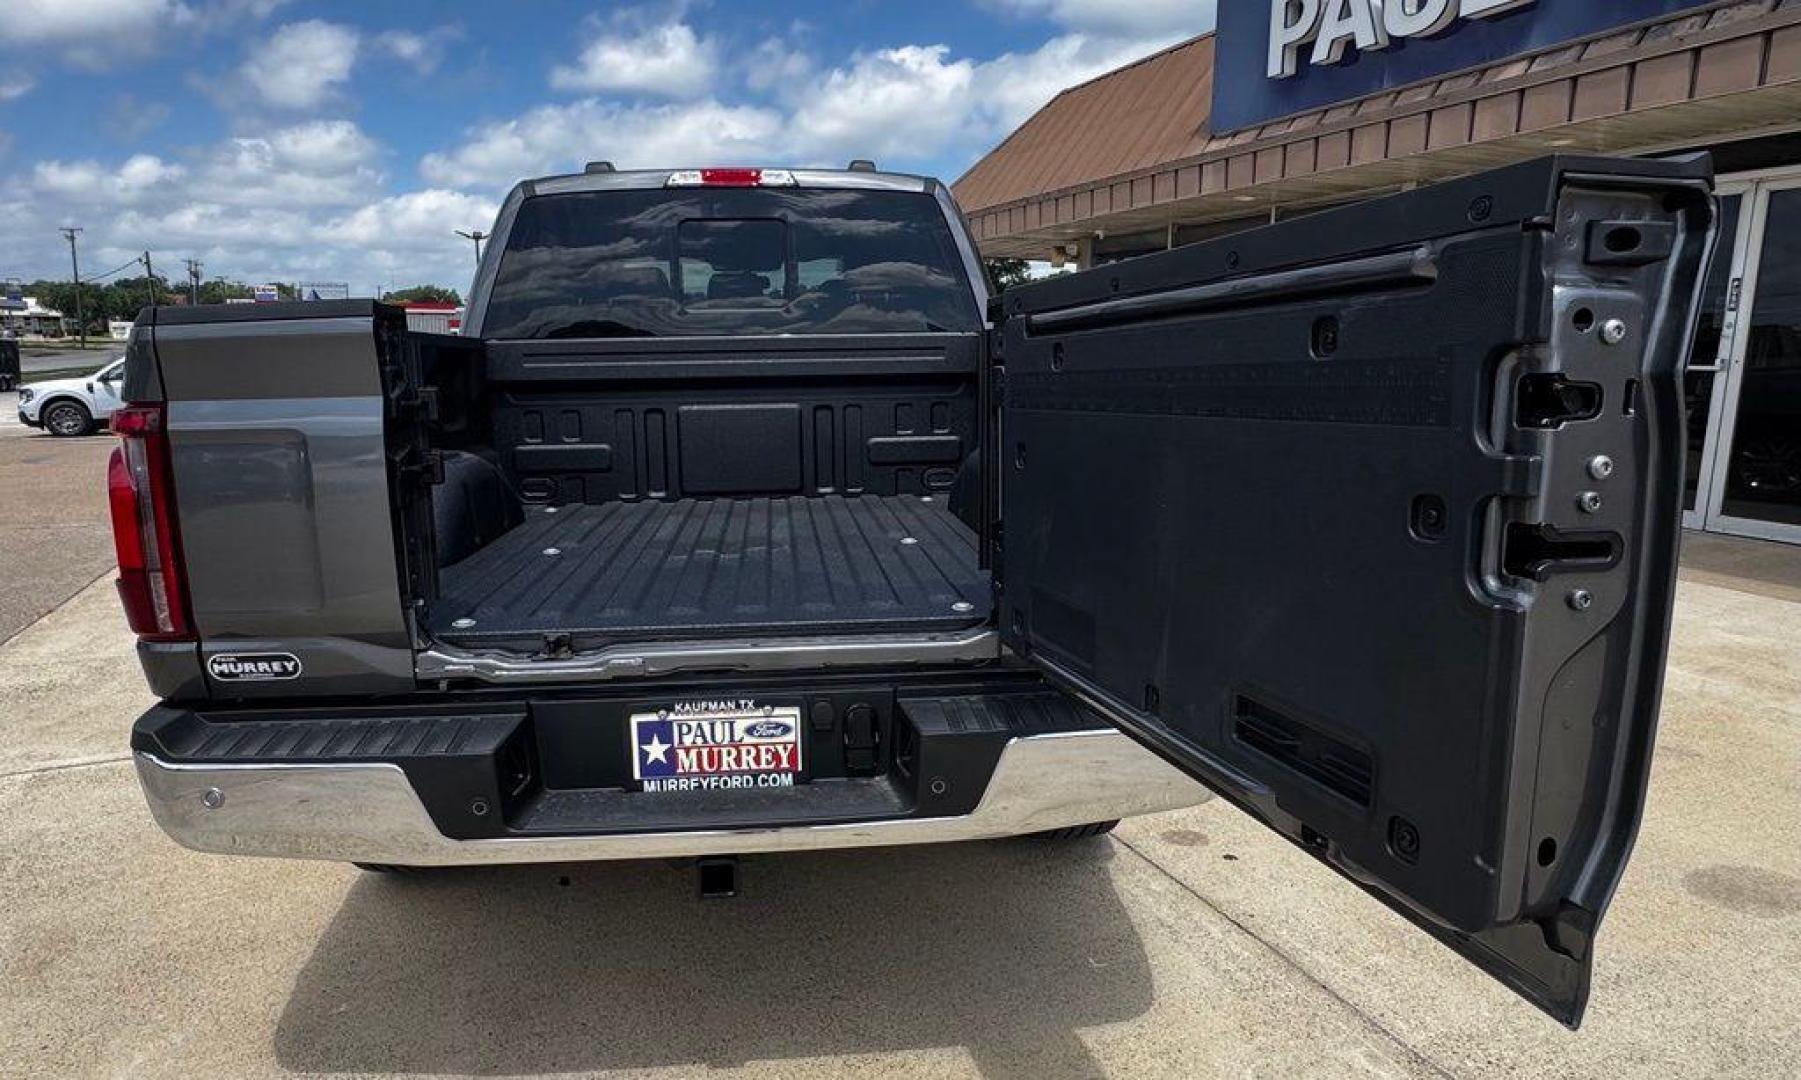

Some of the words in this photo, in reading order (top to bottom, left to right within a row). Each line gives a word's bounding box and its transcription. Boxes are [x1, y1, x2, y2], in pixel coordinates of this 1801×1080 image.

[1267, 0, 1538, 79] PAU
[212, 661, 296, 673] MURREY
[674, 700, 736, 712] KAUFMAN
[739, 699, 756, 710] TX
[677, 719, 745, 745] PAUL
[752, 723, 785, 736] Ford
[676, 744, 795, 773] MURREY
